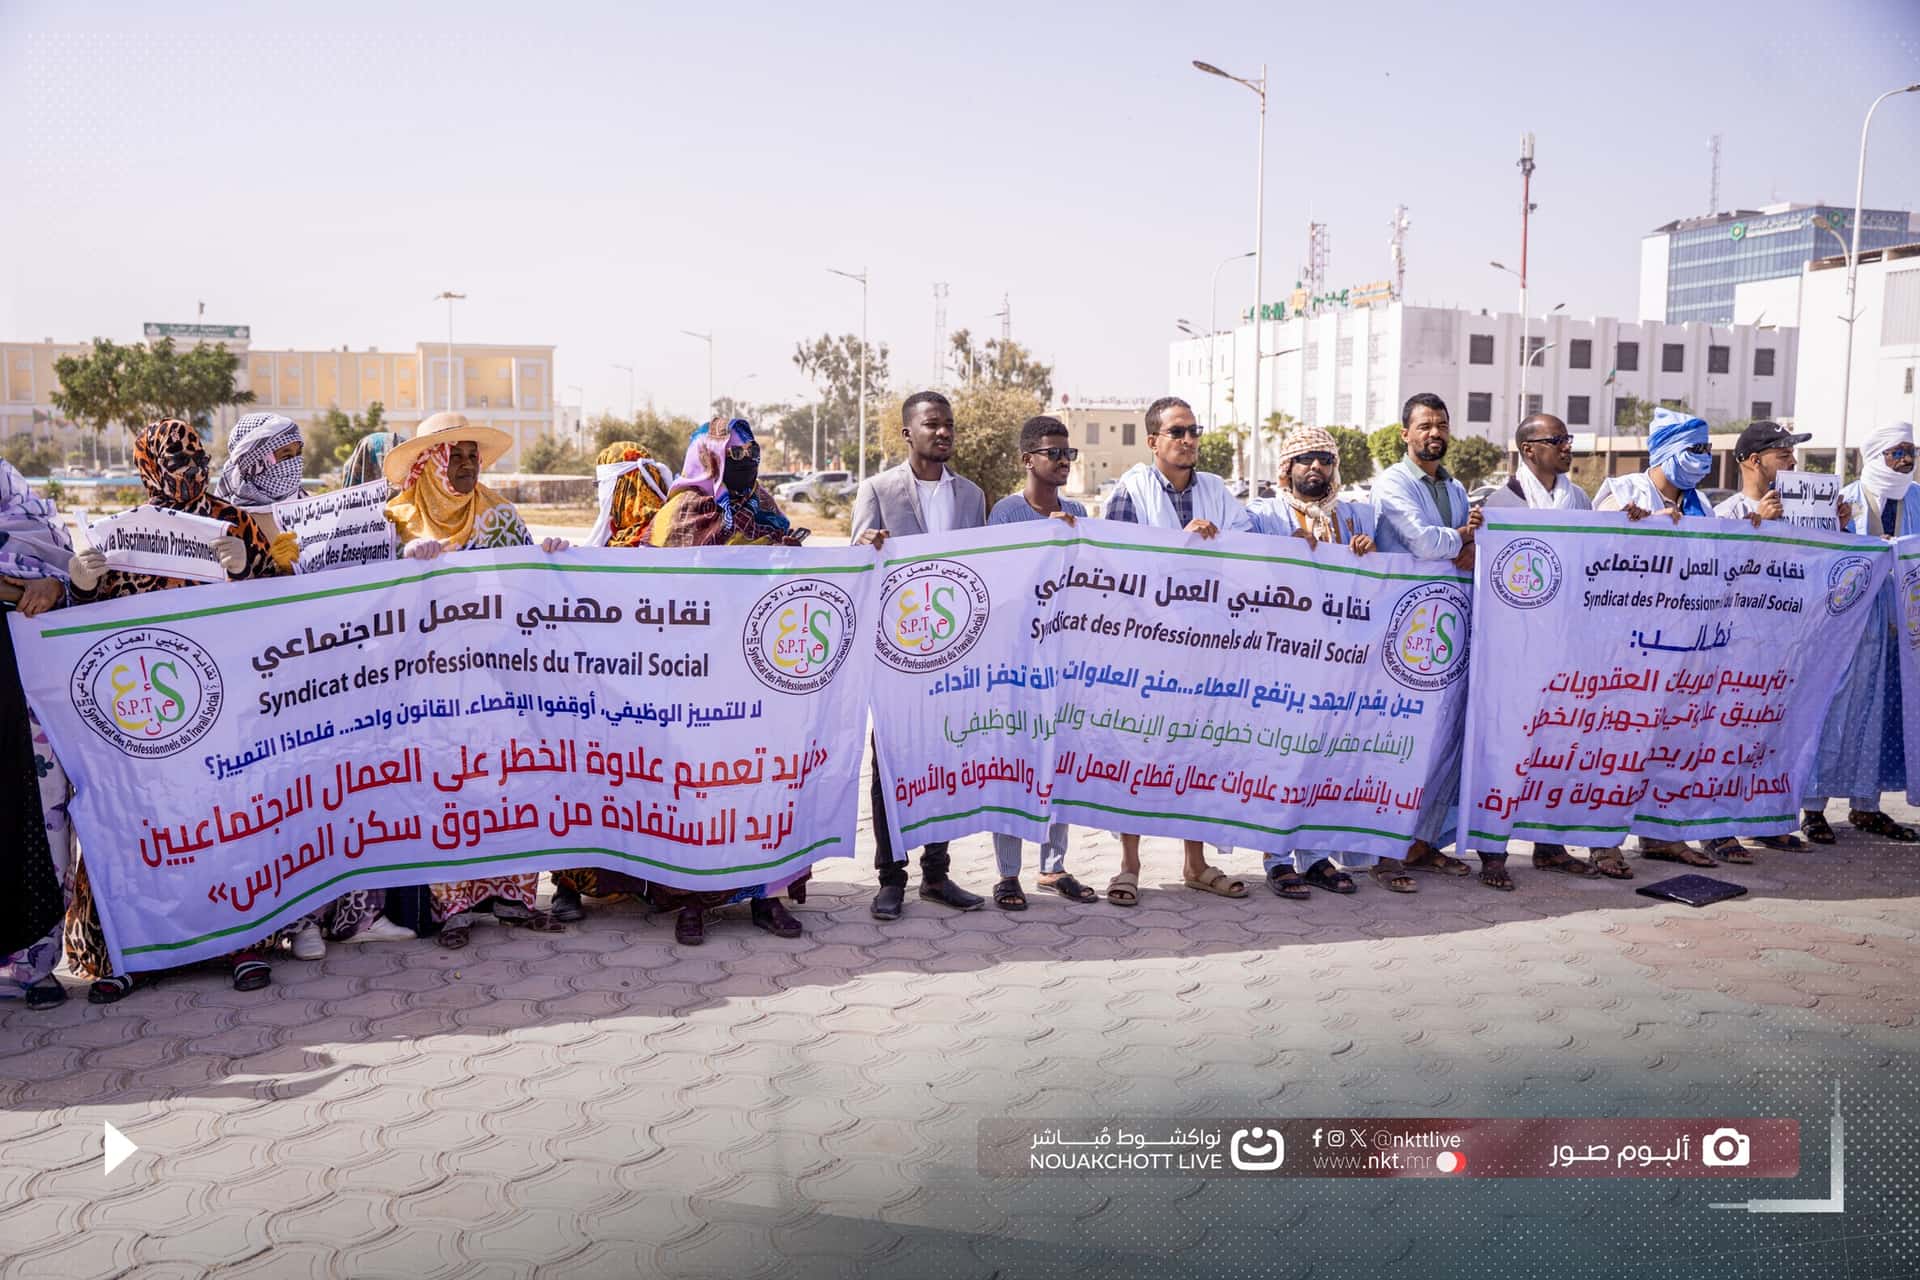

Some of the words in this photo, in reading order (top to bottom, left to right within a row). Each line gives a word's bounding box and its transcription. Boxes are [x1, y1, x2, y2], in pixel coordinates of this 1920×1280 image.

[117, 528, 169, 555] Discrimination
[325, 545, 340, 566] des
[341, 540, 390, 565] Enseignants
[1585, 553, 1673, 582] الاجتماعي
[1679, 558, 1718, 580] العمل
[1766, 558, 1805, 583] نقابة
[1034, 565, 1147, 607] الاجتماعي
[1155, 576, 1221, 608] العمل
[1227, 584, 1312, 619] مهنيي
[1583, 590, 1629, 611] Syndicat
[1631, 591, 1652, 608] des
[1734, 593, 1766, 609] Travail
[1767, 595, 1803, 614] Social
[419, 594, 502, 634] العمل
[516, 597, 622, 636] مهنيي
[635, 598, 710, 633] نقابة
[1322, 592, 1371, 625] نقابة
[115, 633, 151, 650] العمل
[155, 638, 190, 651] مهنيي
[252, 608, 405, 680] الاجتماعي
[1030, 610, 1088, 644] Syndicat
[1090, 613, 1121, 637] des
[1123, 617, 1242, 650] Professionnels
[1242, 629, 1262, 650] du
[1266, 631, 1323, 661] Travail
[1324, 641, 1370, 665] Social
[77, 644, 111, 698] الاجتماعي
[193, 650, 217, 681] نقابة
[258, 672, 349, 717] Syndicat
[353, 665, 389, 690] des
[395, 647, 538, 681] Professionnels
[543, 649, 569, 674] du
[574, 651, 643, 676] Travail
[648, 652, 709, 677] Social
[986, 663, 1026, 693] تحفز
[1062, 659, 1139, 688] العلاوات
[774, 676, 820, 691] Professionnels
[1251, 680, 1306, 714] يرتفع
[397, 699, 460, 725] القانون
[686, 700, 747, 728] للتمييز
[750, 699, 762, 719] لا
[1309, 691, 1356, 717] الجهد
[1390, 692, 1425, 719] حين
[83, 707, 117, 739] Syndicat
[113, 733, 125, 747] des
[124, 739, 181, 755] Professionnels
[180, 734, 190, 745] du
[187, 715, 209, 738] Travail
[207, 691, 221, 717] Social
[280, 720, 334, 753] فلماذا
[1090, 708, 1165, 744] الإنصاف
[1166, 718, 1199, 743] نحو
[1201, 719, 1253, 747] خطوة
[204, 737, 277, 781] التمييز؟
[1324, 732, 1360, 758] مقرر
[323, 747, 422, 811] العمال
[433, 744, 489, 793] على
[498, 738, 577, 787] الخطر
[586, 741, 664, 787] علاوة
[674, 746, 767, 801] تعميم
[961, 756, 1034, 793] والطفولة
[1076, 753, 1130, 784] العمل
[1130, 763, 1175, 795] قطاع
[896, 764, 956, 807] والأسرة
[1175, 766, 1218, 796] عمال
[1221, 771, 1278, 804] علاوات
[1306, 777, 1342, 808] مقرر
[1343, 775, 1392, 814] بإنشاء
[1744, 772, 1790, 802] العمل
[1546, 787, 1564, 809] و
[139, 773, 313, 869] الاجتماعيين
[432, 796, 540, 850] صندوق
[549, 795, 593, 837] من
[601, 795, 736, 848] الاستفادة
[745, 800, 795, 850] نريد
[344, 810, 421, 859] سكن
